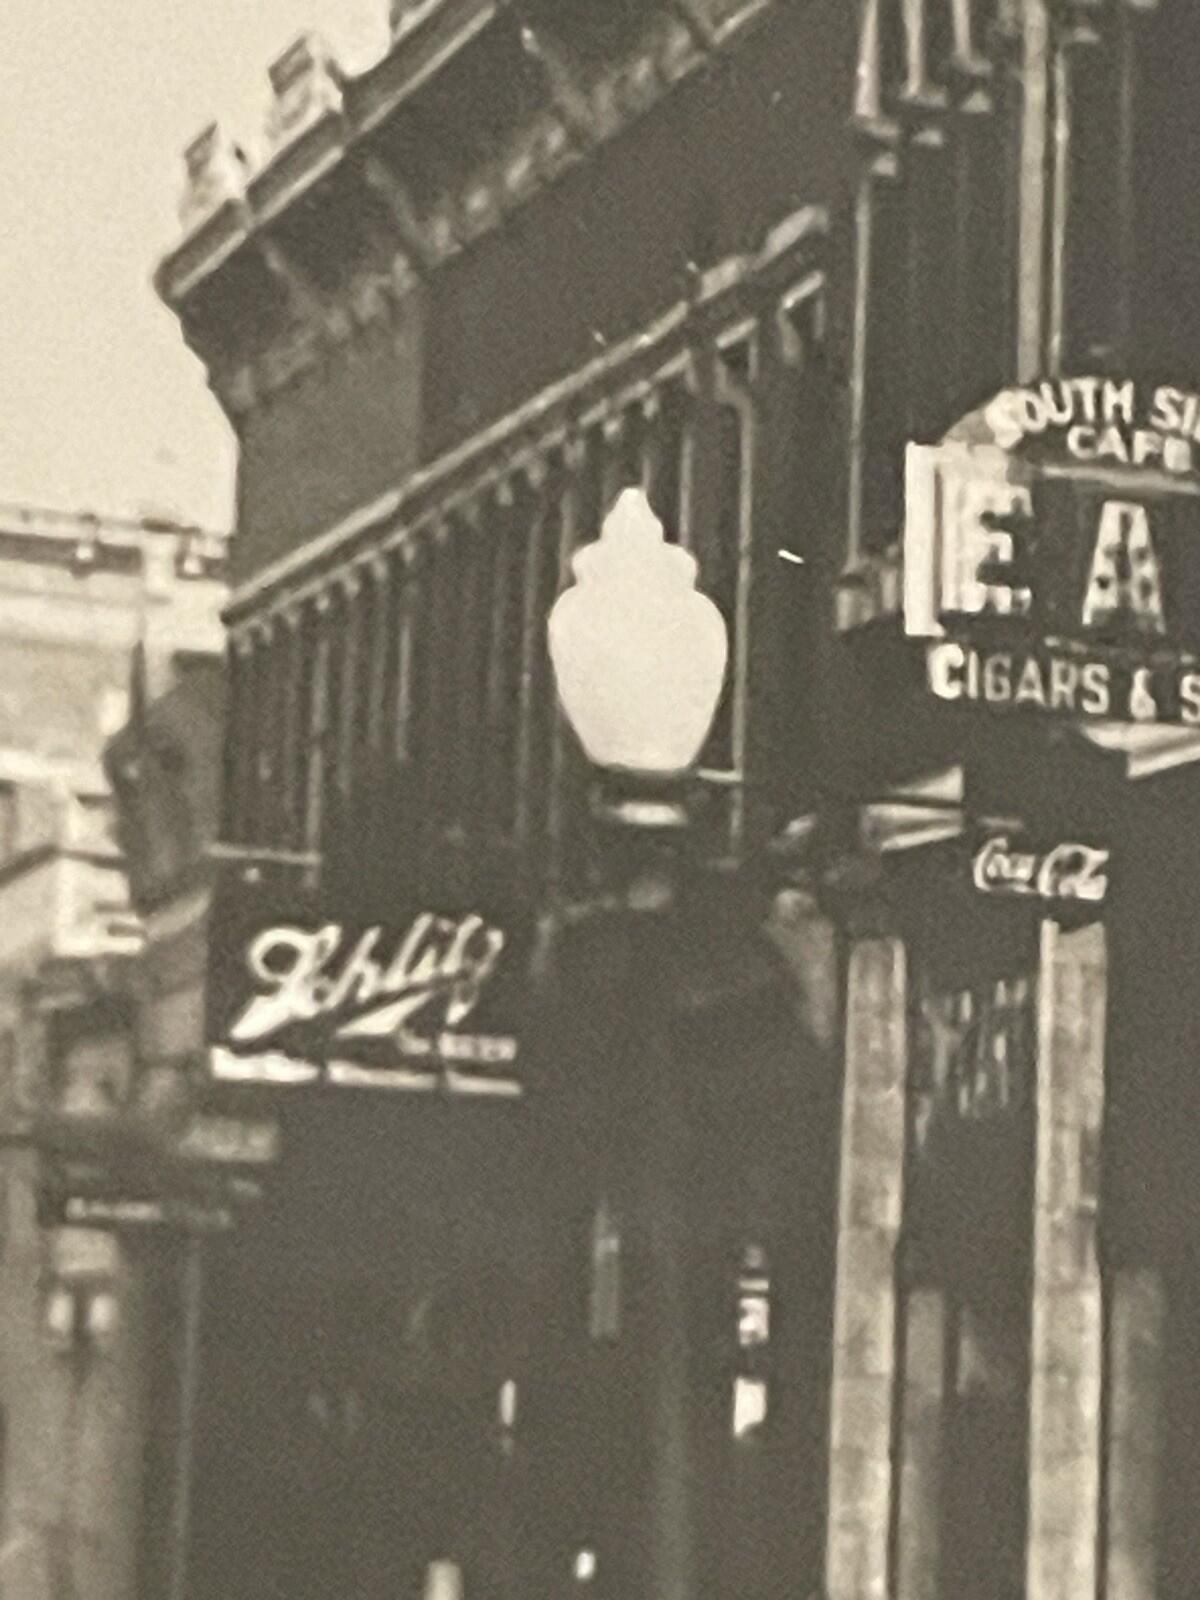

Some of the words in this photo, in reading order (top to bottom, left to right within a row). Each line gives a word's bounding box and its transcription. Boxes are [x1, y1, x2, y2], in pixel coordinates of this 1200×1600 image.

[985, 376, 1134, 449] SOUTH
[1149, 385, 1200, 444] SI
[928, 643, 1110, 714] CIGARS
